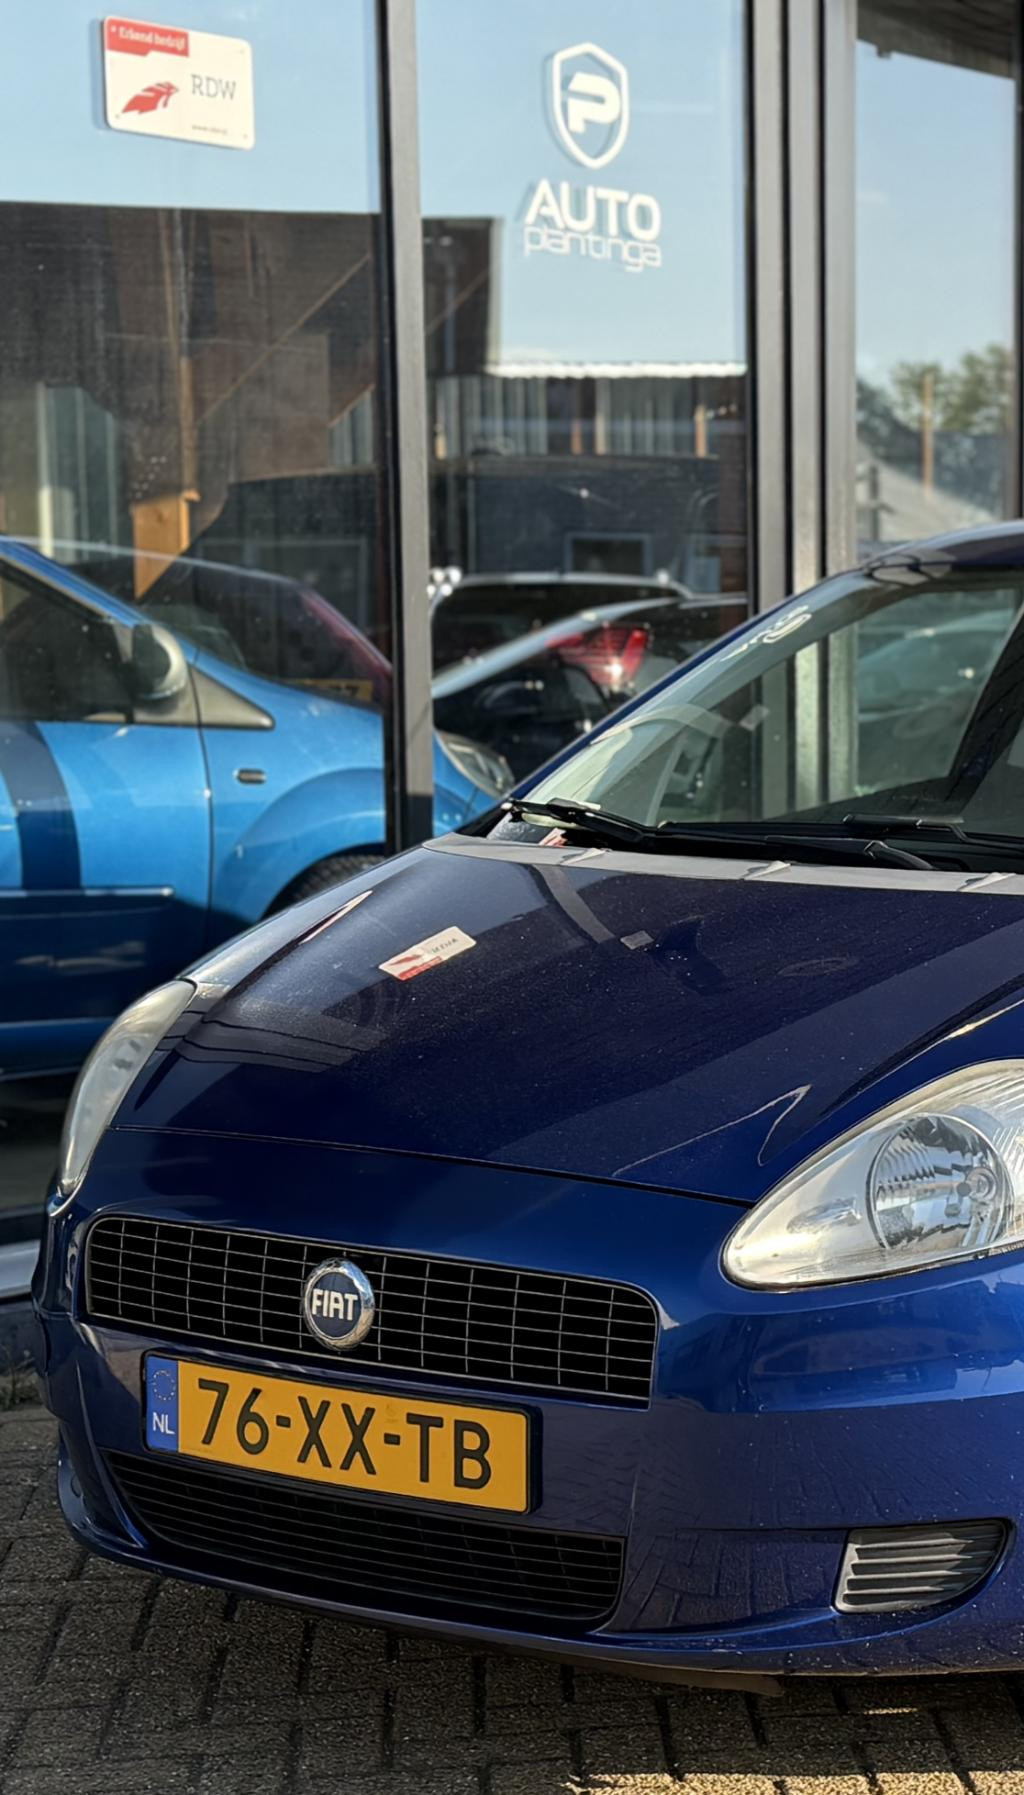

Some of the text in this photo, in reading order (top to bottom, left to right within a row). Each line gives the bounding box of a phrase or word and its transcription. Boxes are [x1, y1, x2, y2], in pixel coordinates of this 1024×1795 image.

[191, 73, 236, 100] RDW
[524, 178, 661, 242] AUTO
[523, 225, 662, 273] plantinga
[311, 1288, 358, 1321] FIAT
[152, 1412, 175, 1435] NL
[197, 1377, 493, 1490] 76-XX-TB
